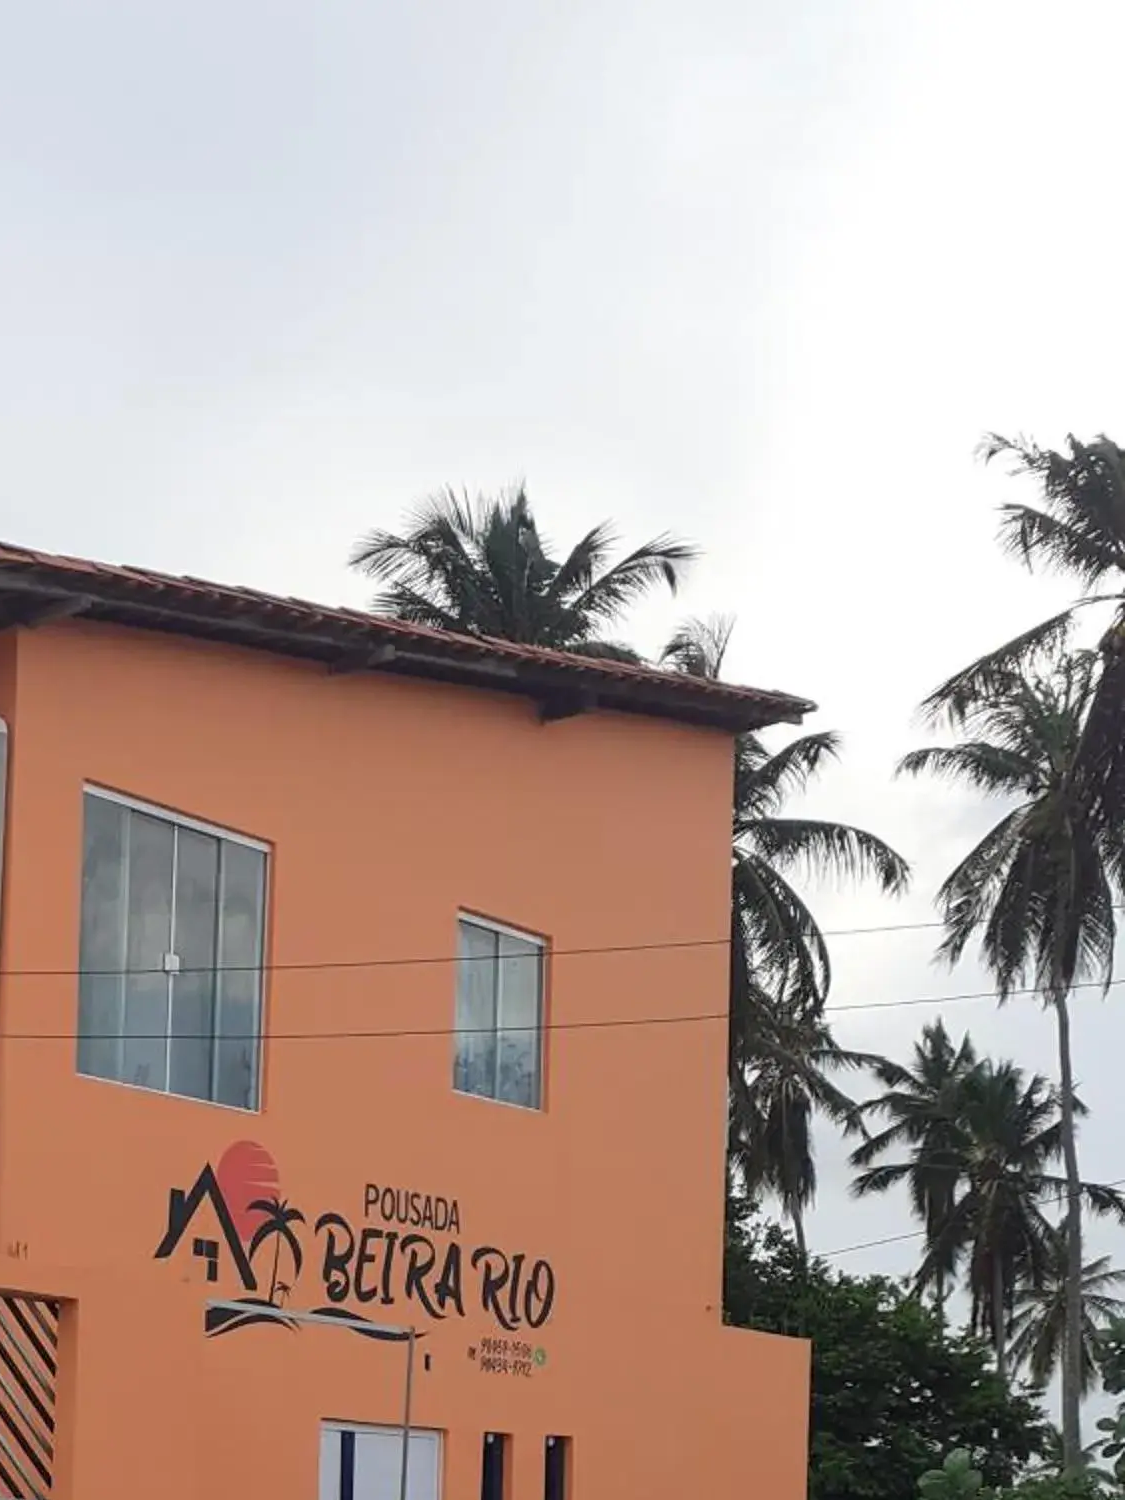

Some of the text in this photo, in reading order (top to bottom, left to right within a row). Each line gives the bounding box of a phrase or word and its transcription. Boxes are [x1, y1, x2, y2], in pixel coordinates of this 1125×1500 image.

[364, 1183, 461, 1234] POUSADA
[314, 1212, 556, 1331] BEIRA RIO
